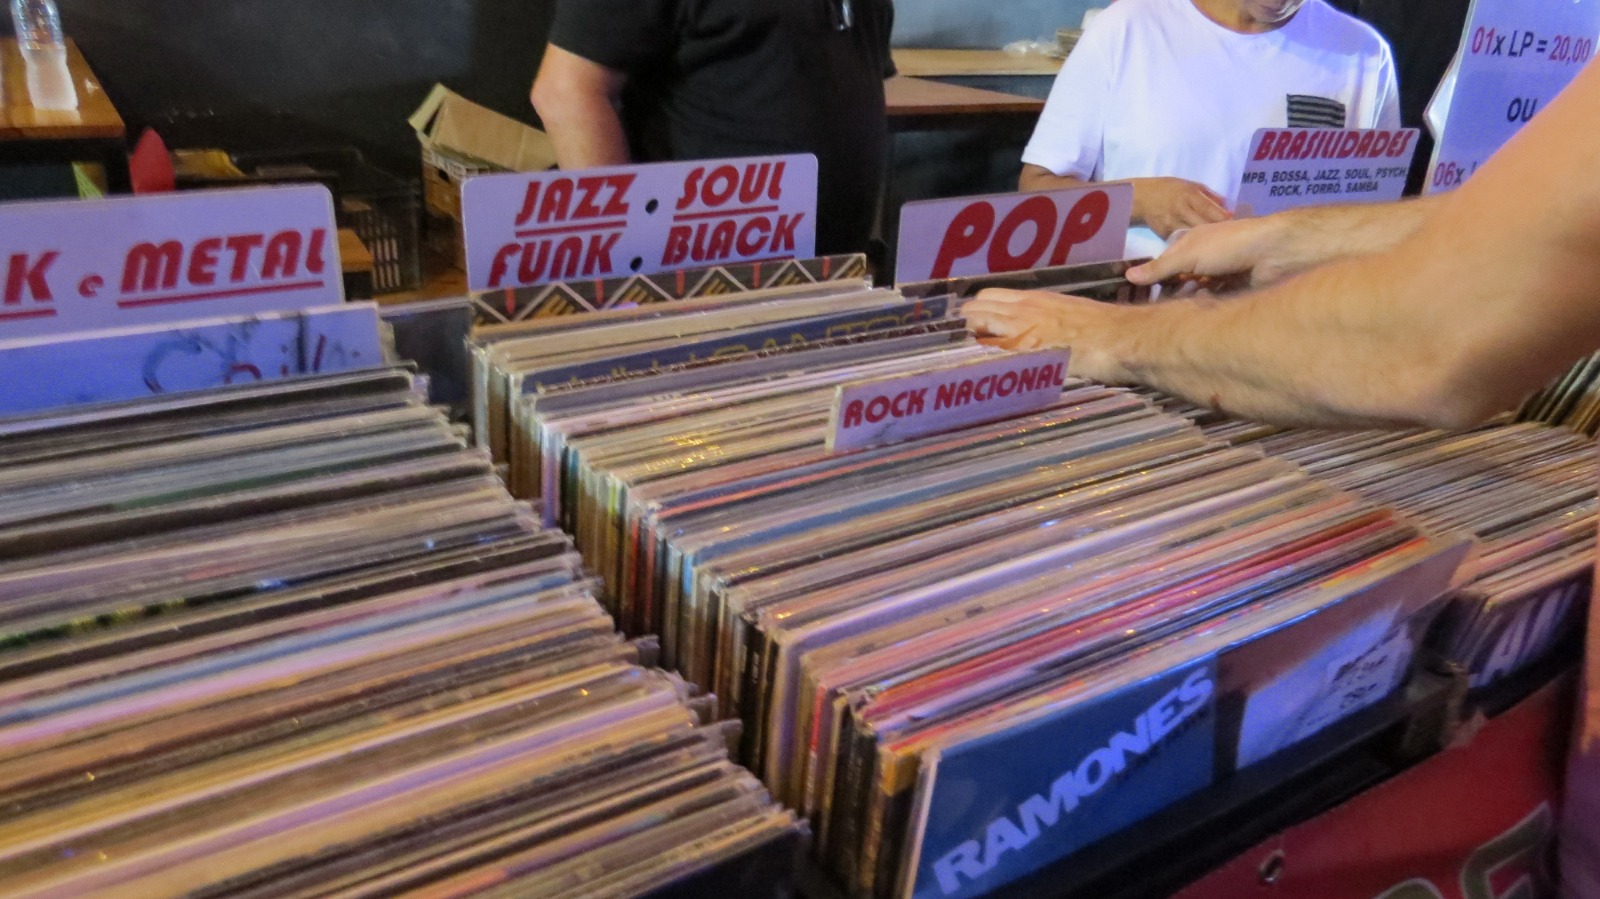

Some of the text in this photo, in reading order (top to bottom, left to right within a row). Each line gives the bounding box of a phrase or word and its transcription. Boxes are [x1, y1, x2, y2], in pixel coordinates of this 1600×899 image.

[1471, 26, 1506, 56] 01x
[1506, 98, 1538, 122] OU
[1253, 130, 1415, 161] BRASILIDADES
[1272, 170, 1310, 183] BOSSA,
[514, 162, 786, 226] JAZZ SOUL
[1345, 181, 1378, 193] SAMBA
[120, 228, 326, 294] METAL
[487, 213, 805, 288] FUNK BLACK
[929, 190, 1110, 280] POP
[843, 362, 1063, 428] ROCK NACIONAL
[933, 666, 1214, 894] RAMONES
